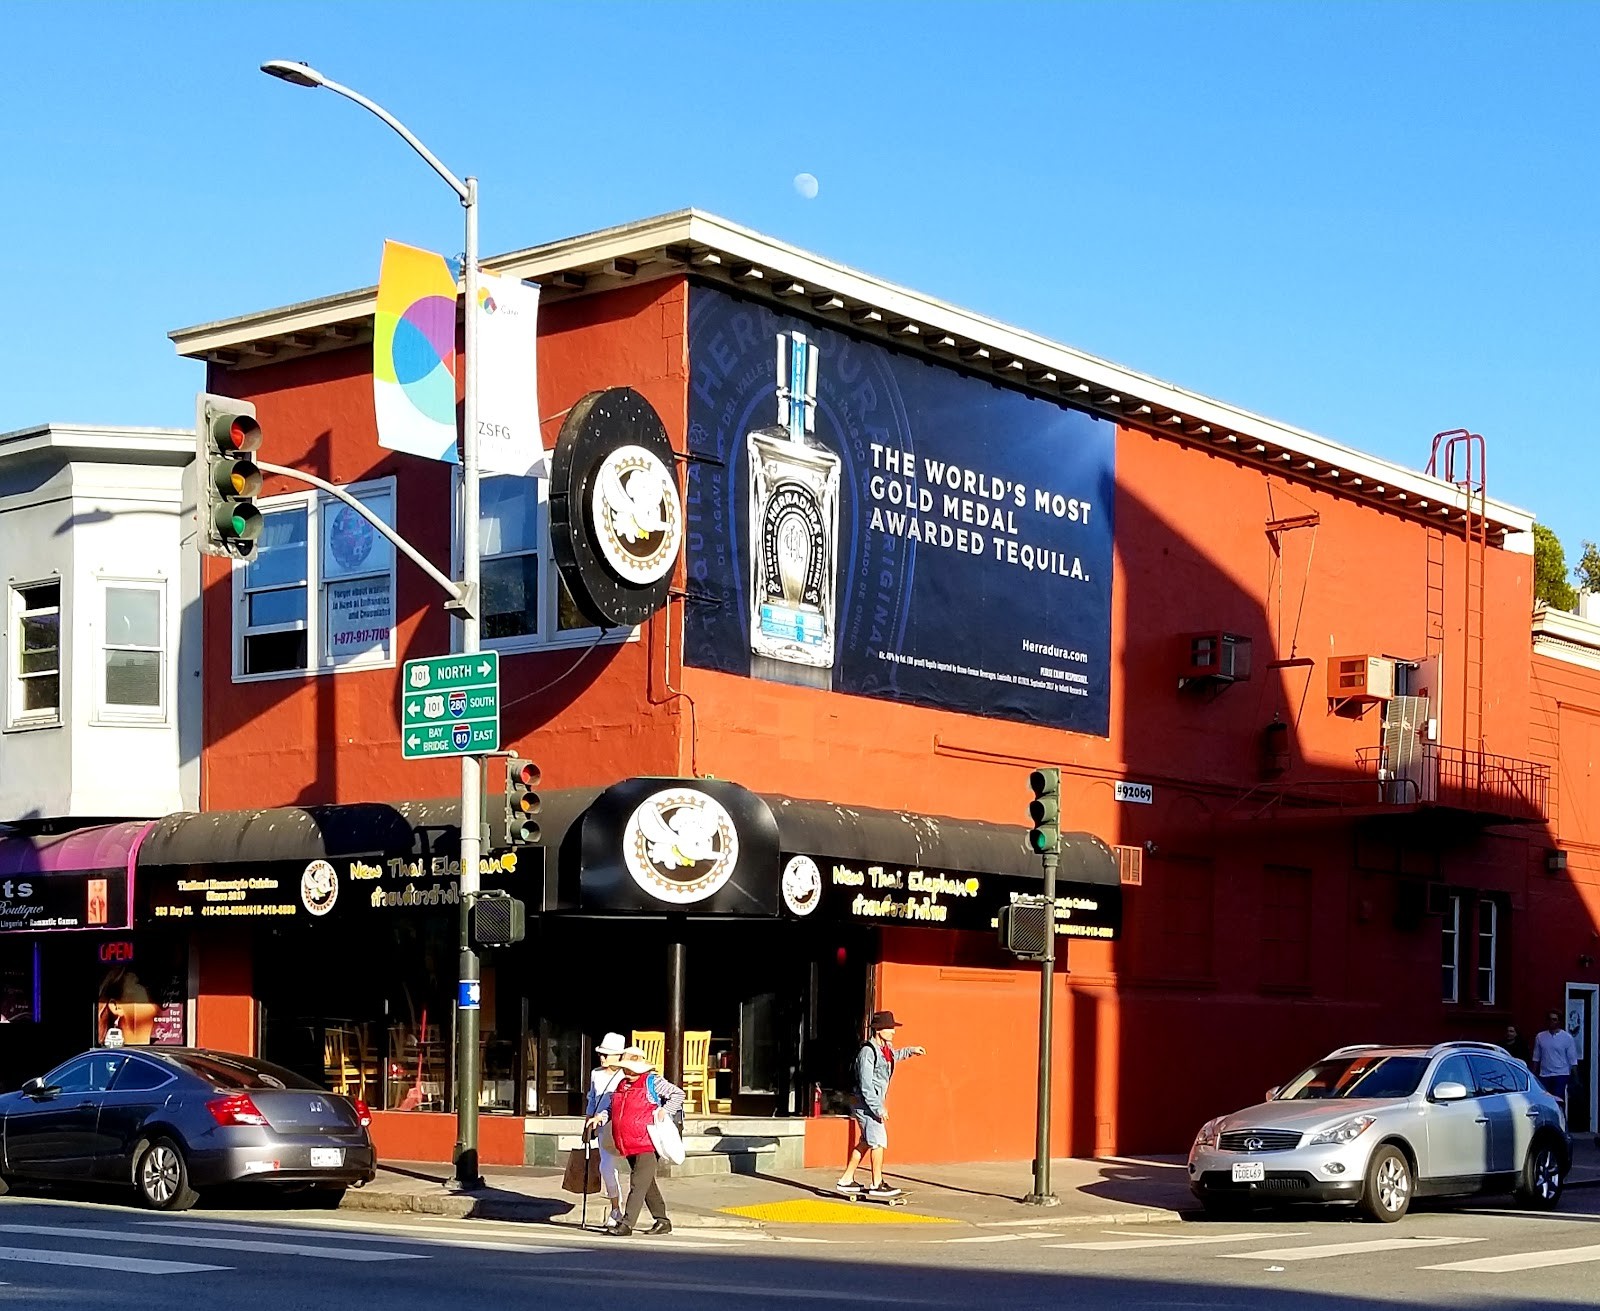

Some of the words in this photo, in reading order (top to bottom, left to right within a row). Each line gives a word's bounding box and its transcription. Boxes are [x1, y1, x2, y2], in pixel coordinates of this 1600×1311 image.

[478, 421, 511, 440] ZSFG
[870, 442, 916, 478] THE
[924, 458, 1027, 508] WORLD'S
[1034, 488, 1092, 525] MOST
[767, 491, 822, 535] HERRADURA
[869, 475, 934, 513] GOLD
[943, 494, 1018, 535] MEDAL
[869, 506, 985, 556] AWARDED
[992, 537, 1091, 582] TEQUILA.
[1022, 639, 1088, 664] Herradura.com
[414, 671, 427, 681] 101
[437, 664, 472, 680] NORTH
[428, 702, 440, 712] 101
[450, 699, 466, 711] 280
[469, 696, 495, 708] SOUTH
[423, 739, 449, 752] BRIDGE
[455, 733, 468, 744] 80
[473, 729, 494, 741] EAST
[428, 727, 444, 738] BAY
[350, 860, 383, 880] New
[387, 857, 427, 879] Thai
[832, 864, 865, 886] New
[868, 866, 904, 889] Thai
[100, 943, 134, 961] OPEN
